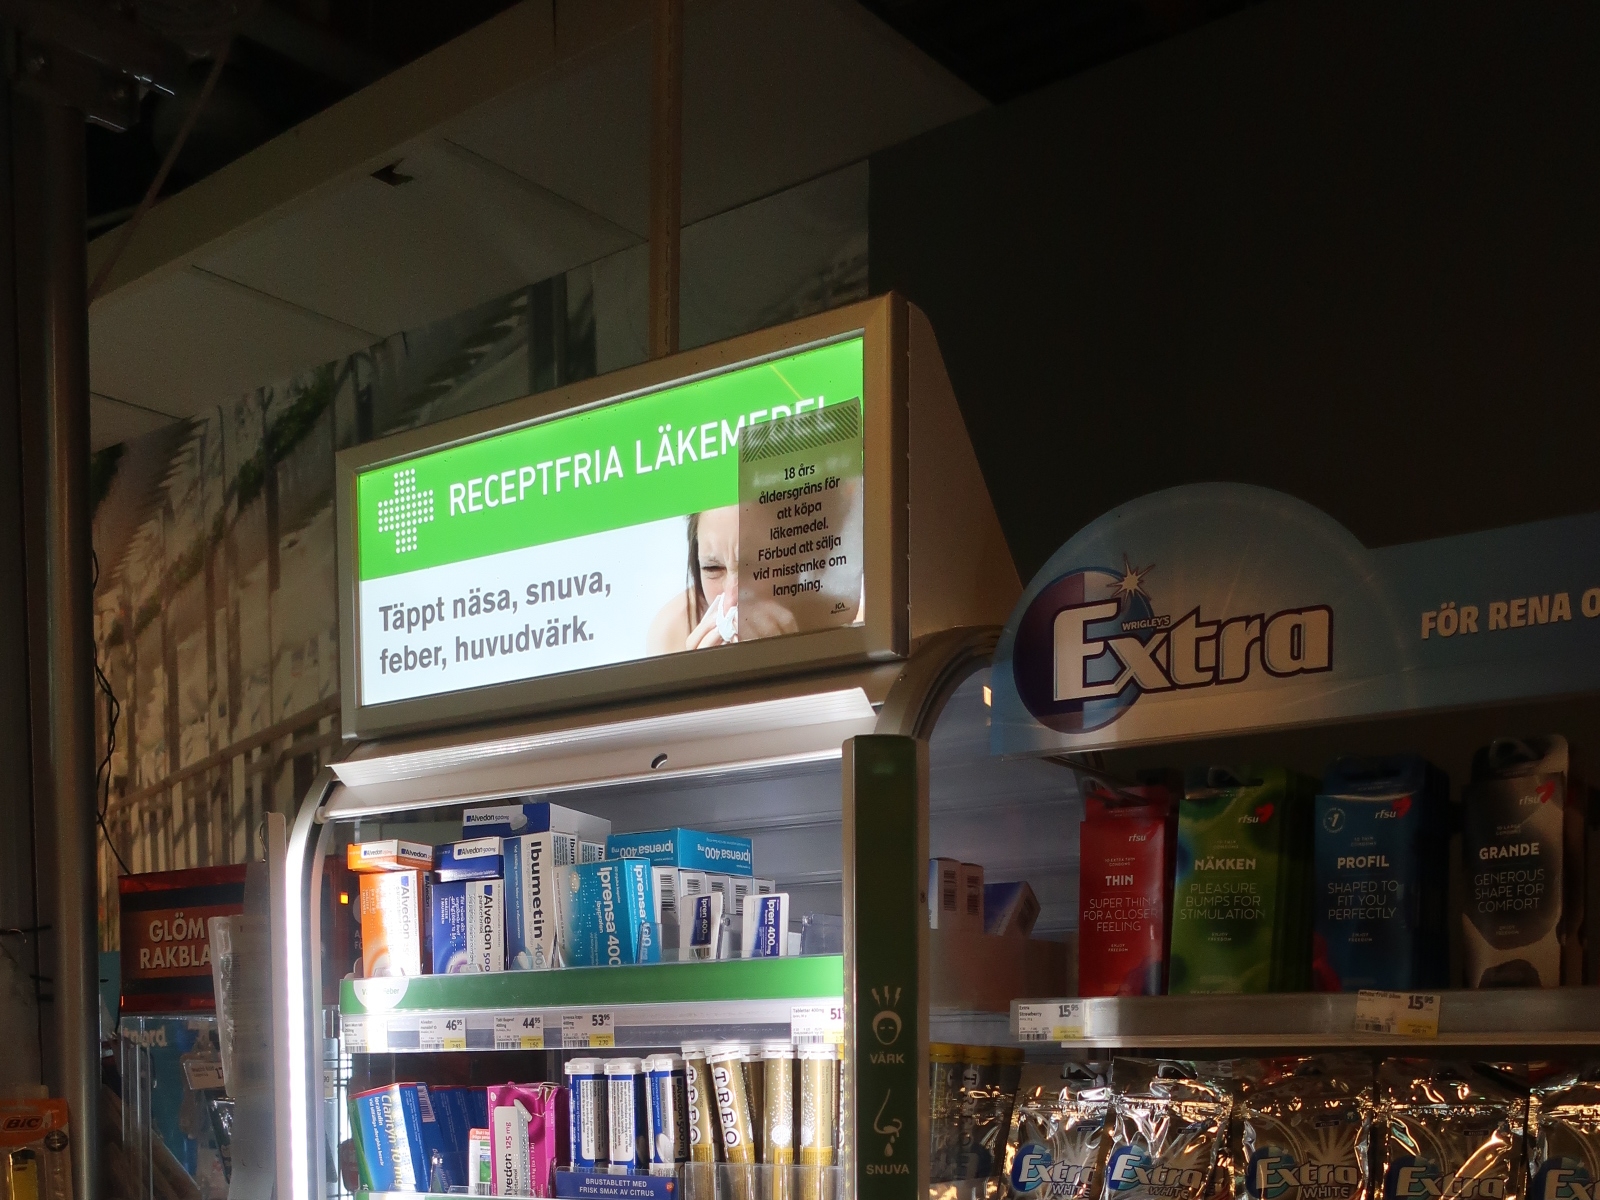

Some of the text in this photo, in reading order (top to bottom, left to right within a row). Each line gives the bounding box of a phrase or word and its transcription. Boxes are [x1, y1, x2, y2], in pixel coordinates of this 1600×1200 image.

[784, 462, 816, 480] 18 års
[448, 445, 625, 517] RECEPTFRIA
[758, 476, 841, 505] åldersgräns för
[777, 501, 822, 520] att köpa
[770, 517, 829, 541] läkemedel.
[758, 535, 842, 562] Förbud att sälja
[753, 555, 847, 581] vid misstanke om
[773, 578, 824, 597] langning.
[378, 569, 613, 633] Täppt näsa, snuva,
[1121, 615, 1171, 633] WRIGLEY'S
[1420, 603, 1480, 641] FÖR
[1487, 593, 1573, 632] RENA
[379, 617, 596, 679] feber, huvudvärk.
[1052, 599, 1334, 703] Extra
[619, 846, 638, 858] 400
[638, 839, 674, 855] Iprensa
[1478, 842, 1541, 861] GRANDE
[1194, 856, 1257, 871] NÄKKEN
[1337, 855, 1390, 870] PROFIL
[1105, 874, 1134, 887] THIN
[1474, 868, 1546, 887] GENEROUS
[530, 840, 543, 940] Ibumetin
[1190, 882, 1257, 895] PLEASURE
[1327, 880, 1399, 894] SHAPED TO
[1474, 883, 1545, 901] SHAPE FOR
[1089, 897, 1152, 910] SUPER THIN
[1185, 896, 1261, 908] BUMPS FOR
[1337, 894, 1387, 907] FIT YOU
[1477, 897, 1541, 914] COMFORT
[601, 866, 621, 966] Iprensa 400
[1083, 907, 1158, 921] FOR A CLOSER
[1180, 908, 1266, 921] STIMULATION
[1327, 907, 1397, 921] PERFECTLY
[483, 895, 493, 972] Alvedon 500
[1096, 921, 1142, 933] FEELING
[870, 1051, 905, 1064] VÄRK
[714, 1071, 737, 1145] TREO
[6, 1117, 41, 1130] BIC
[381, 1094, 396, 1142] Clarityn
[391, 1145, 400, 1163] 10
[866, 1164, 910, 1175] SNUVA
[1019, 1153, 1096, 1185] Extra
[1110, 1155, 1203, 1190] Extra
[1255, 1155, 1358, 1190] Extra
[579, 1186, 598, 1194] FRISK
[599, 1187, 616, 1195] SMAK
[630, 1188, 655, 1197] CITRUS
[585, 1177, 648, 1188] BRUSTABLETT MED
[1051, 1183, 1090, 1198] WHITE
[1396, 1165, 1504, 1200] Extra
[1149, 1186, 1190, 1200] WHITE
[1302, 1186, 1349, 1199] WHITE
